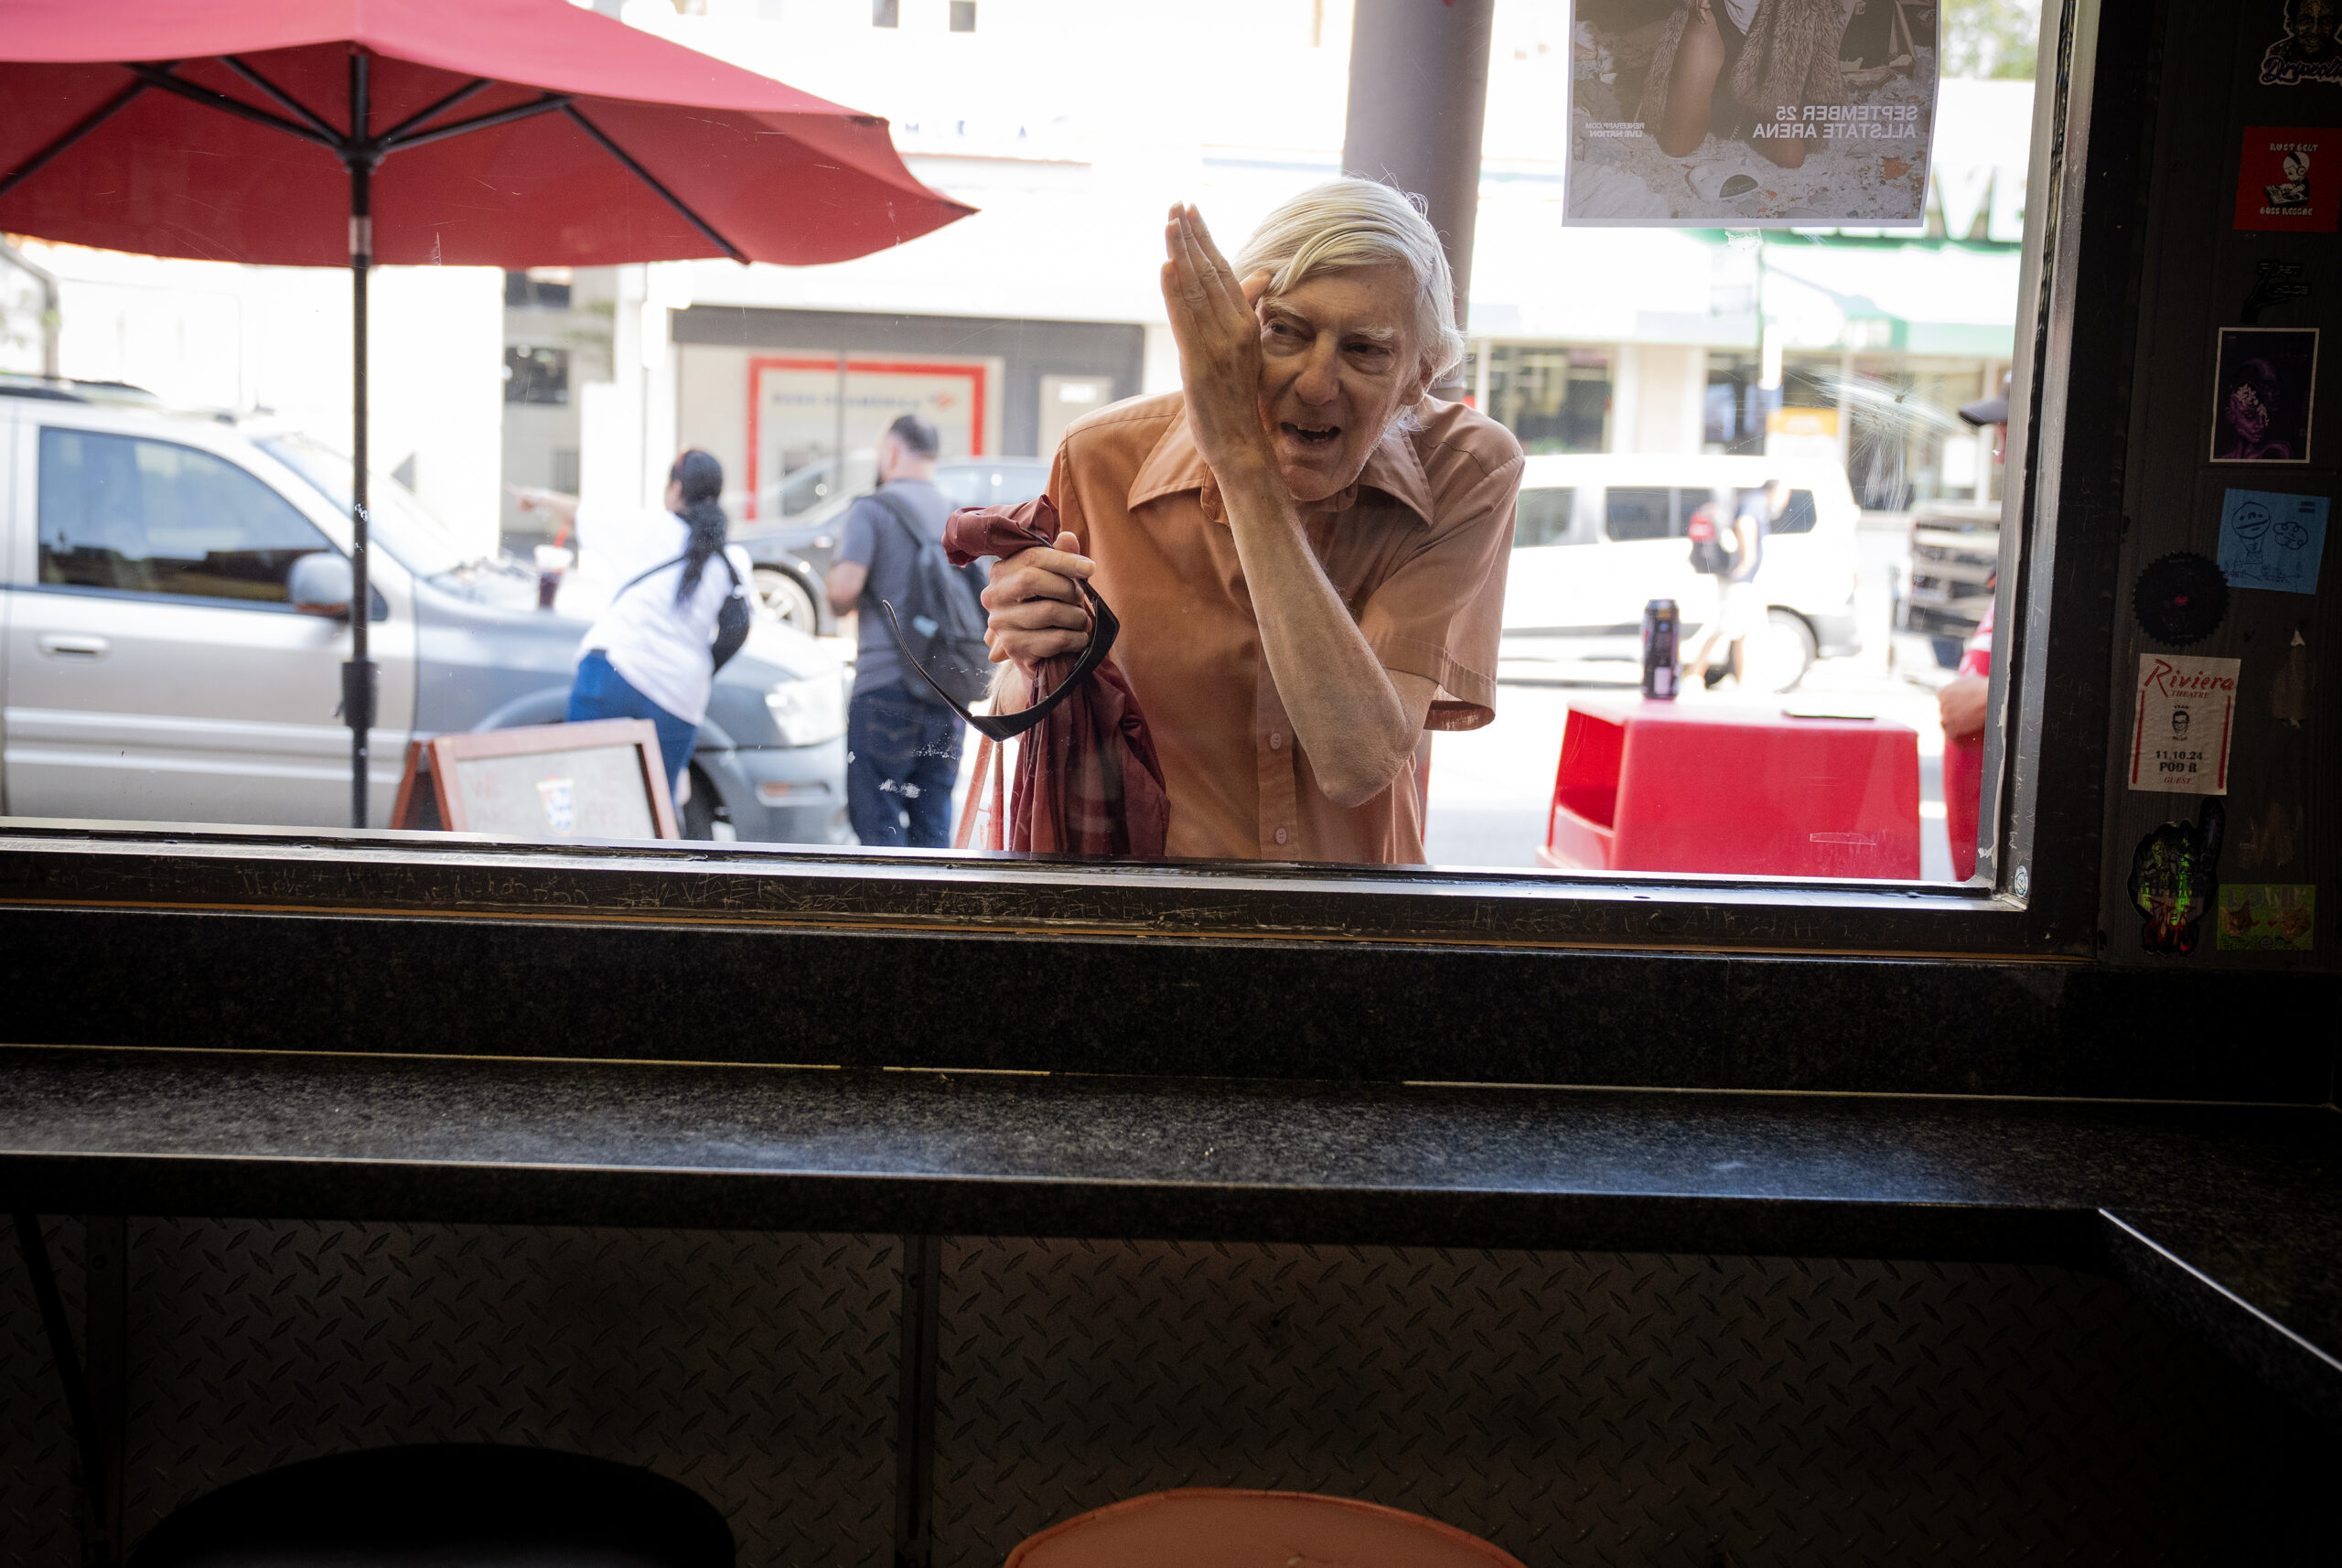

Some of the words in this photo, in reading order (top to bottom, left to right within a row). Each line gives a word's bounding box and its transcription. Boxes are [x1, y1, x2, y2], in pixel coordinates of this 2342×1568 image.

[2269, 142, 2295, 152] RUST
[2282, 207, 2314, 217] REGGAE
[2143, 658, 2235, 698] Riviera
[2171, 690, 2211, 699] THEATRE
[2155, 749, 2204, 761] 11.10.24
[2159, 761, 2186, 773] POD
[2164, 776, 2193, 785] GUEST
